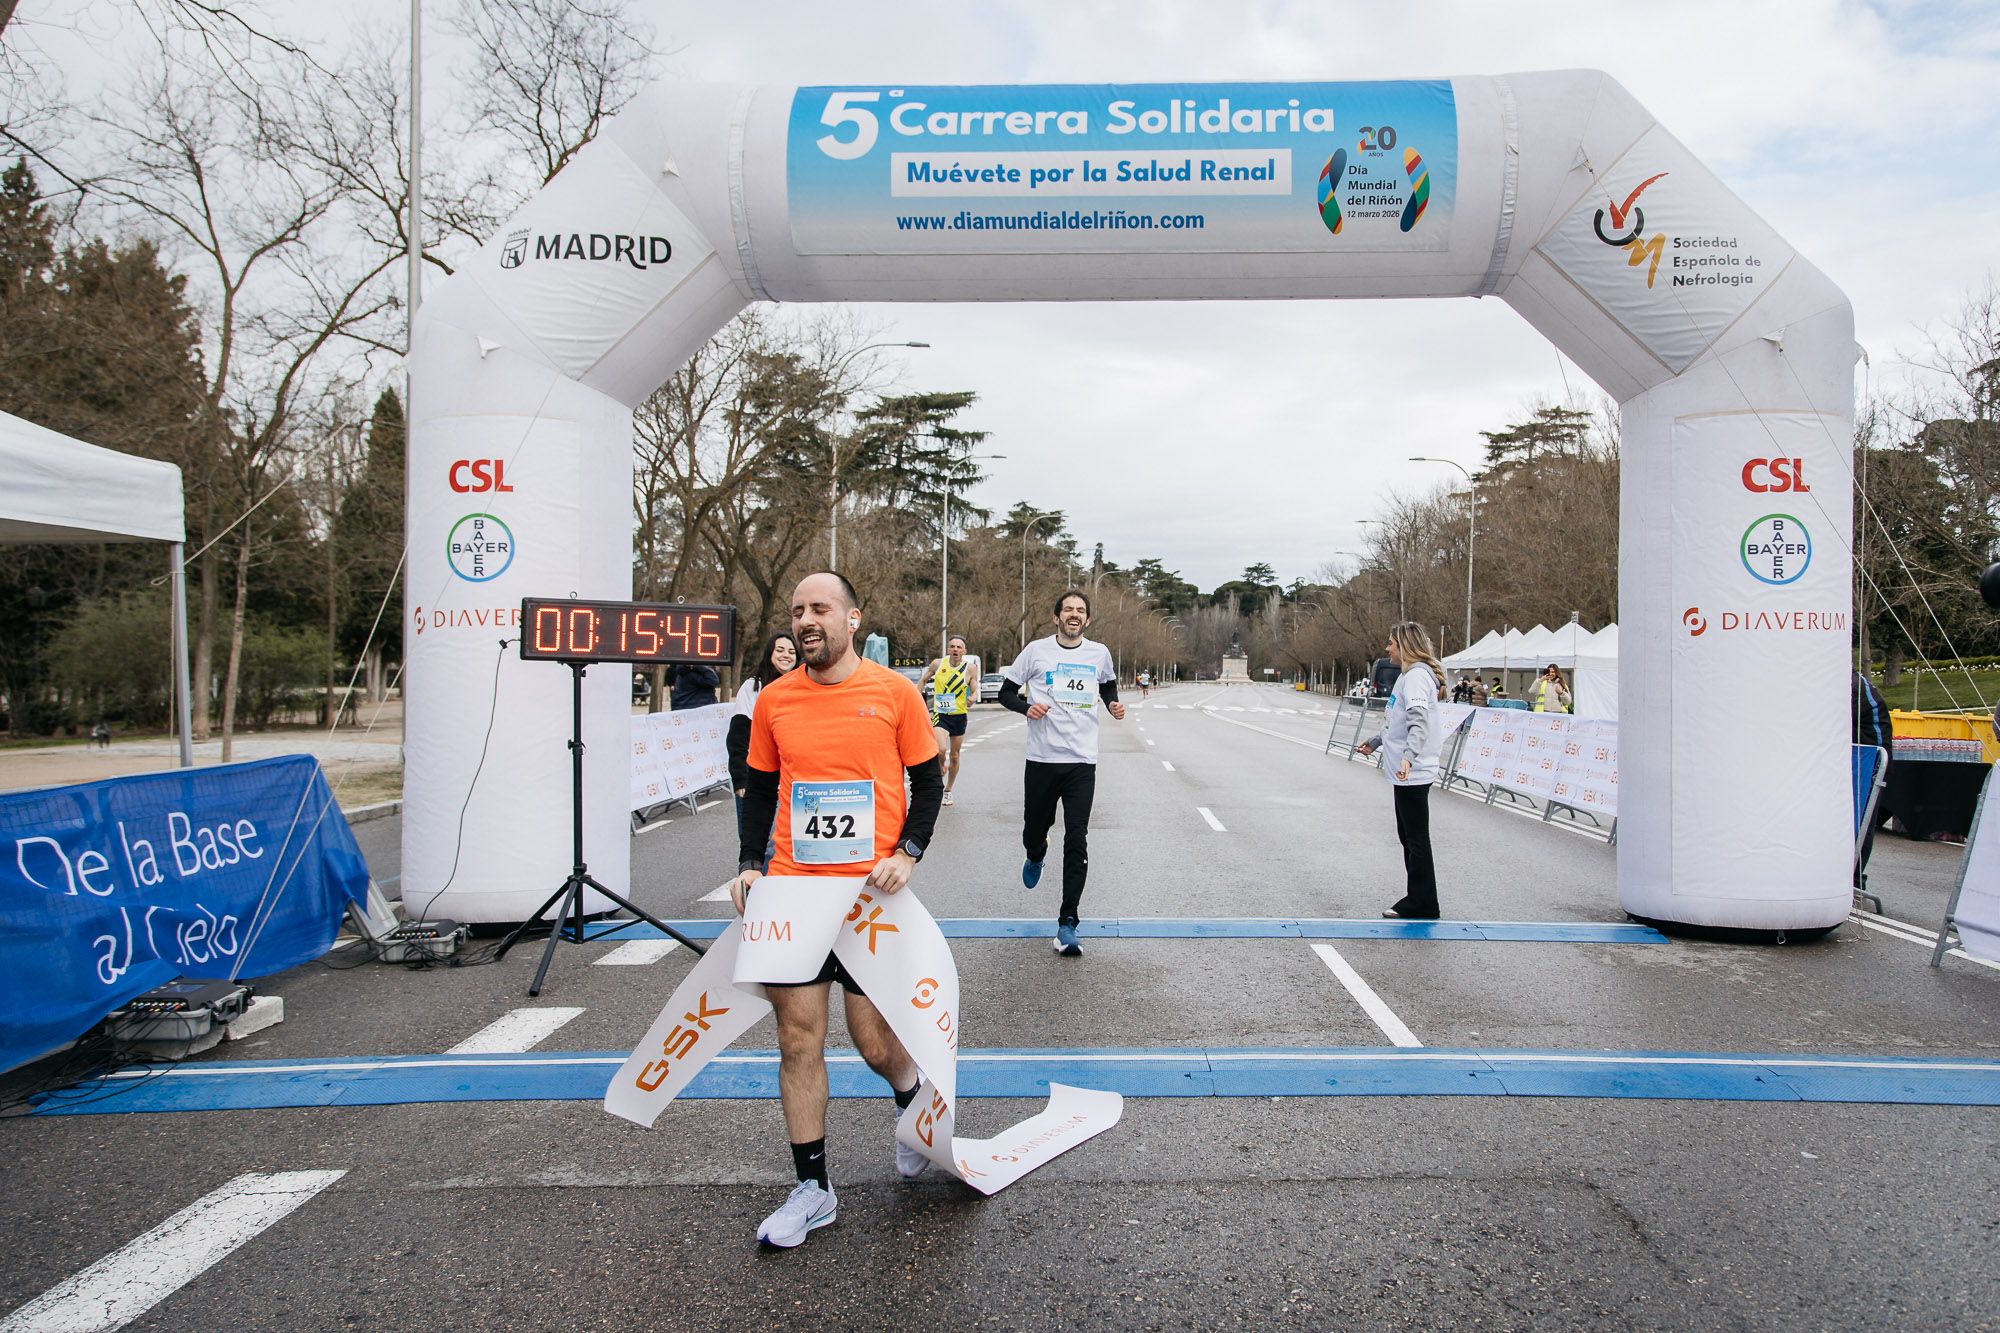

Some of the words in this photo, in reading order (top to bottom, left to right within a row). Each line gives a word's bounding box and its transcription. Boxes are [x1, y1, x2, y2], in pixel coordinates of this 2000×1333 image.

[890, 102, 1088, 136] Carrera
[1105, 98, 1335, 134] Solidaria
[1358, 126, 1397, 151] 20
[907, 162, 1021, 183] Muévete
[1030, 167, 1075, 188] por
[1083, 160, 1107, 182] la
[1116, 159, 1192, 182] Salud
[1200, 158, 1275, 181] Renal
[1348, 165, 1368, 175] Día
[1348, 179, 1397, 190] Mundial
[1347, 195, 1366, 206] del
[896, 210, 1205, 230] www.diamundialdelriñon.com
[1347, 210, 1356, 218] 12
[1382, 210, 1400, 218] 2026
[535, 233, 672, 270] MADRID
[1673, 237, 1738, 248] Sociedad
[1673, 254, 1740, 270] Española
[1745, 256, 1761, 266] de
[449, 459, 514, 493] CSL
[1741, 457, 1811, 493] CSL
[452, 542, 509, 554] BAYER
[1747, 543, 1807, 555] BAYER
[1772, 520, 1784, 579] BAYER
[535, 607, 721, 657] 00:15:46
[1722, 611, 1846, 631] DIAVERUM
[1066, 679, 1085, 691] 46
[805, 815, 856, 839] 432
[118, 821, 164, 888] la
[168, 811, 264, 877] Base
[635, 990, 731, 1093] GSK
[1011, 1115, 1088, 1155] DIAVERUM
